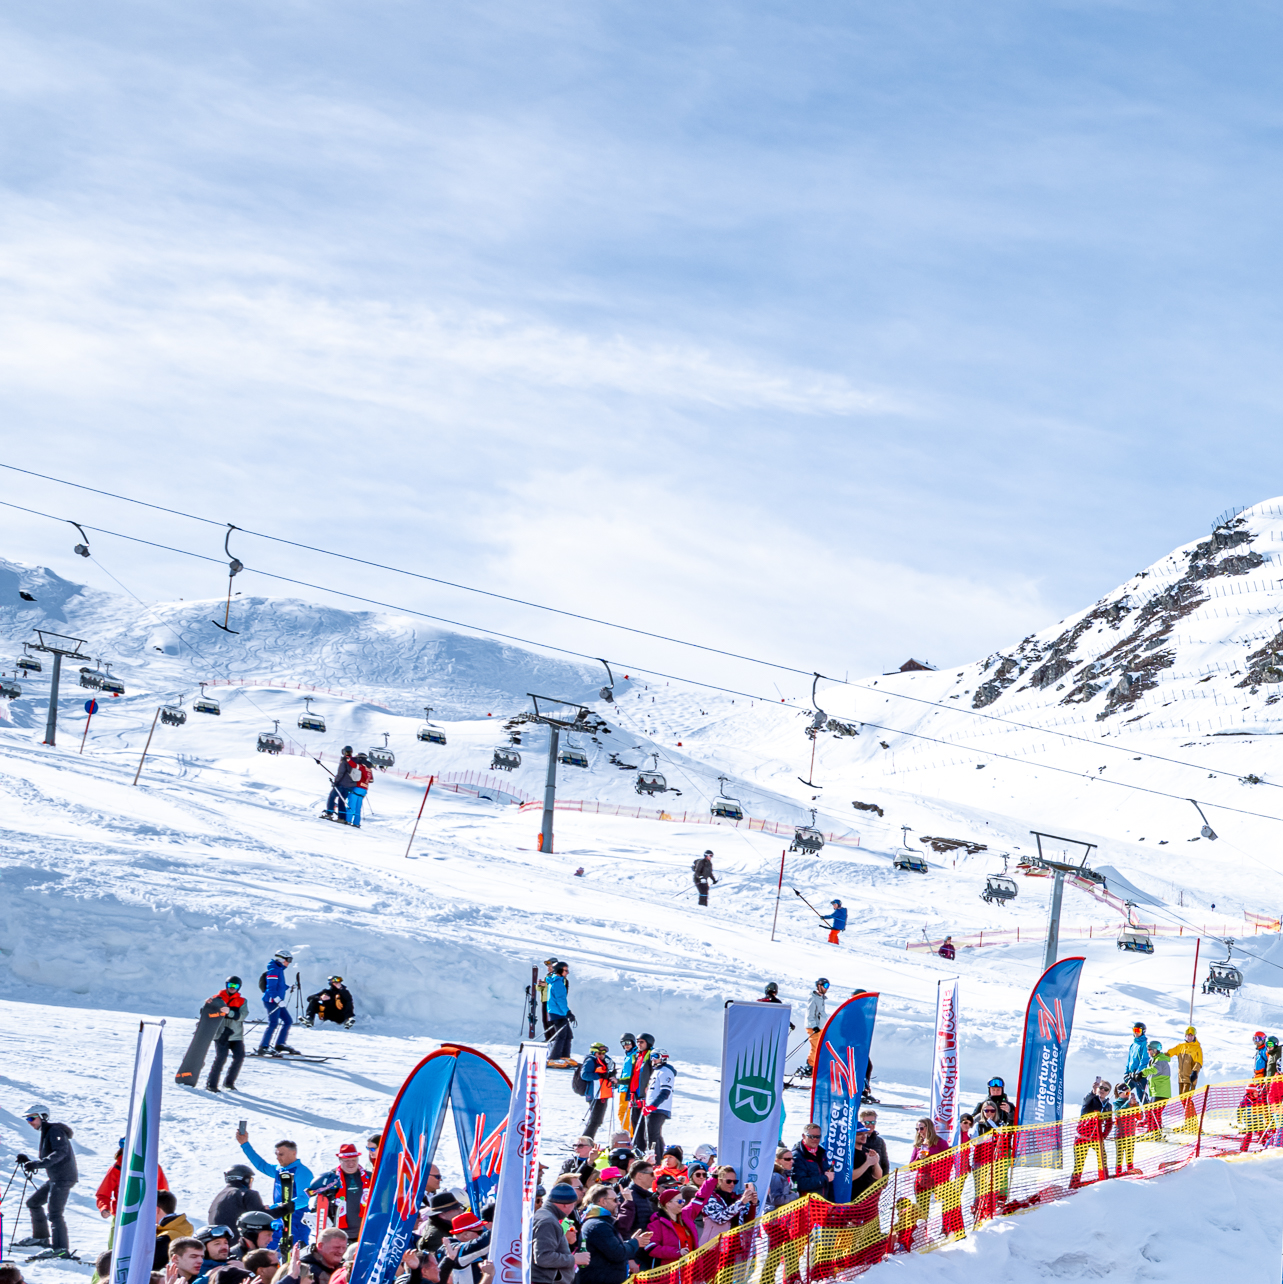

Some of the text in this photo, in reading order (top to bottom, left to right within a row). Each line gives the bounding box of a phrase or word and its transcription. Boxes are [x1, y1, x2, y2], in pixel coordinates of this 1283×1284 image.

[1035, 1045, 1052, 1122] Hintertuxer
[1046, 1044, 1059, 1106] Gletscher
[833, 1099, 849, 1174] Gletscher
